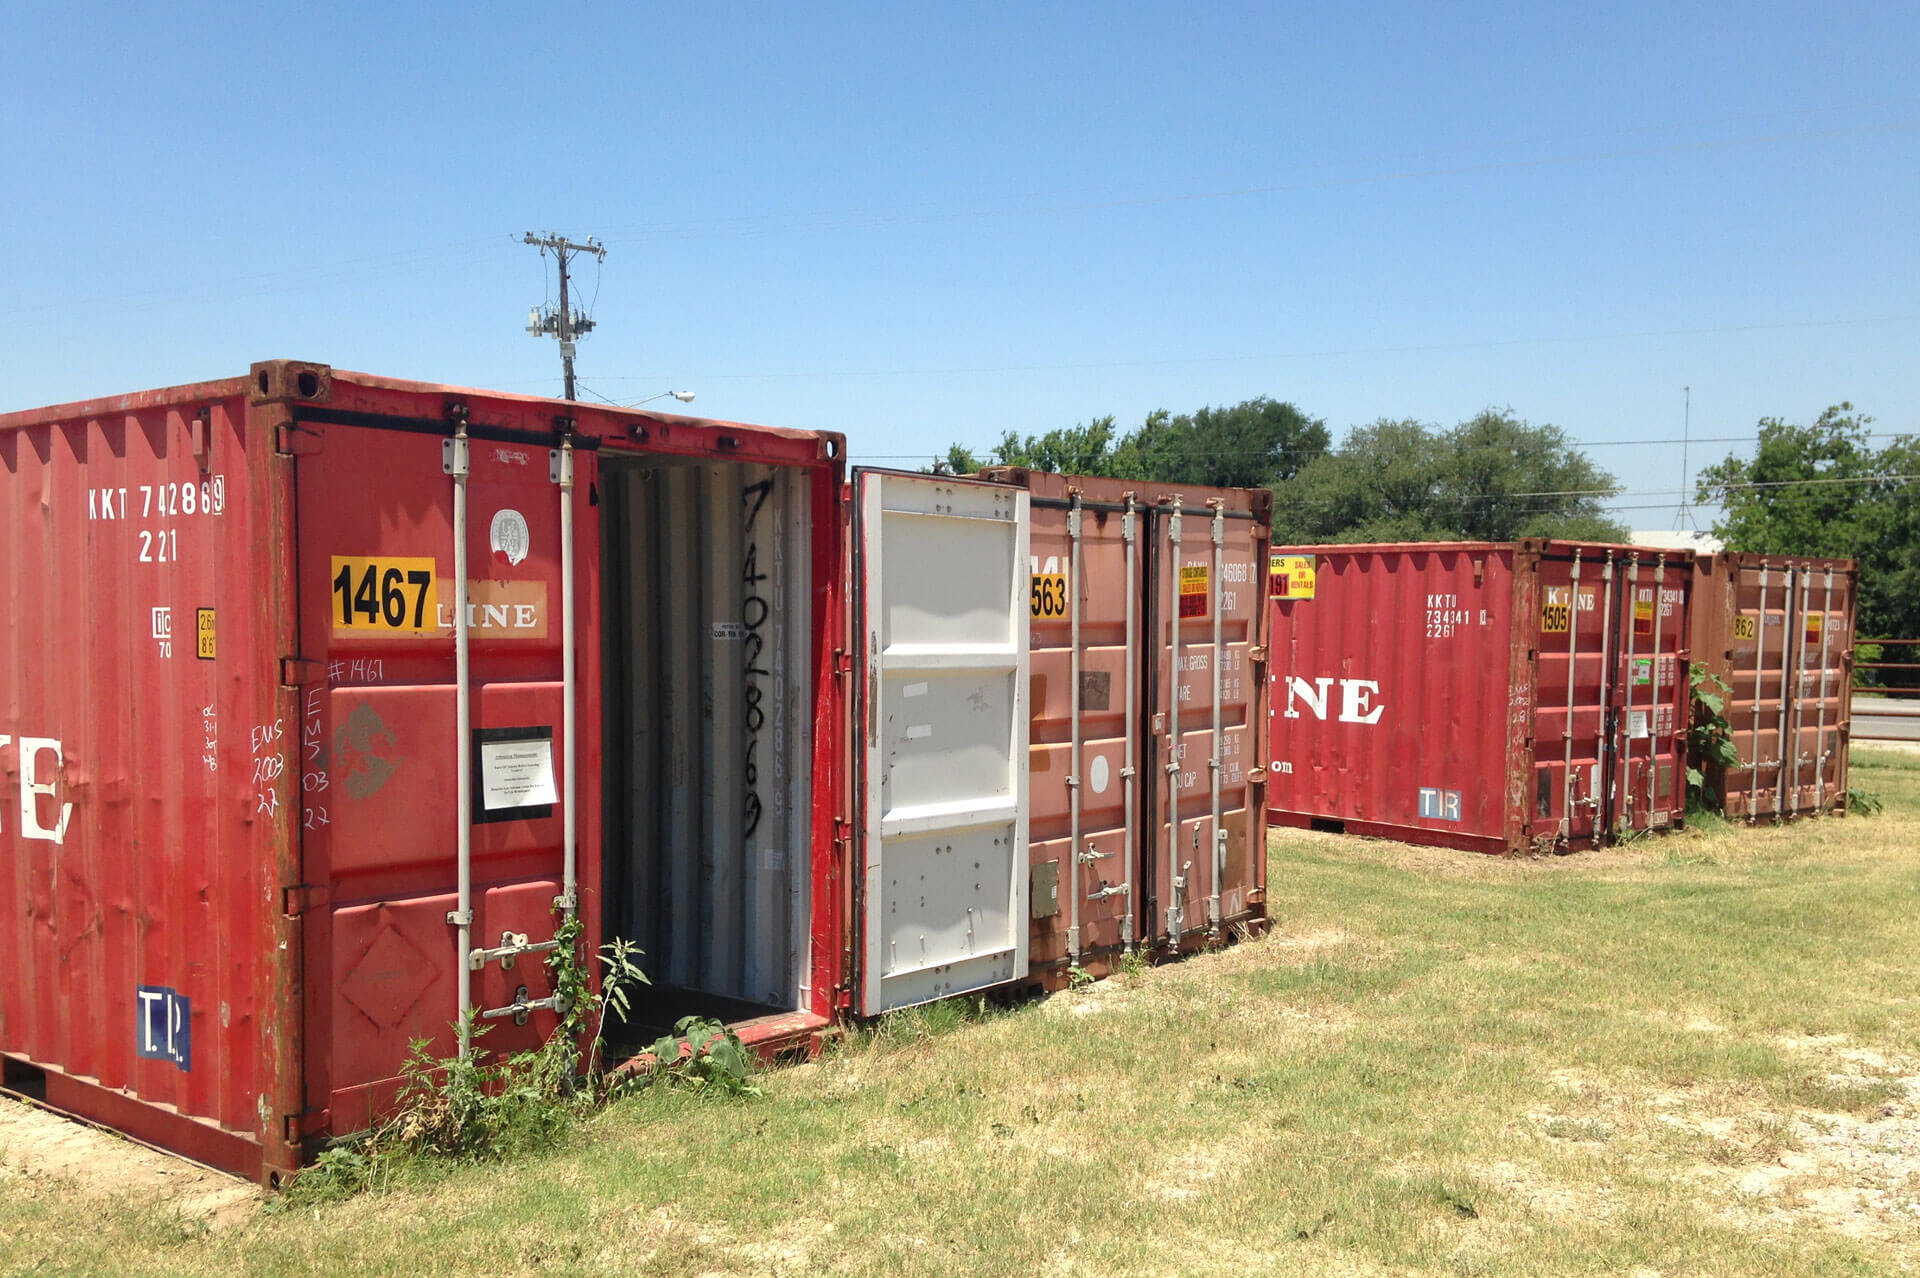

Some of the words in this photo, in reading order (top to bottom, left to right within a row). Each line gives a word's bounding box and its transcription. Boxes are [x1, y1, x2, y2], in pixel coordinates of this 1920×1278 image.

[139, 528, 177, 562] 221
[334, 564, 431, 628] 1467
[1427, 594, 1457, 608] KKTU
[1426, 610, 1470, 625] 734341
[1543, 606, 1567, 630] 1505
[1735, 618, 1753, 638] 862
[1190, 655, 1208, 671] GROSS
[1271, 675, 1385, 725] NE
[1420, 790, 1458, 819] TIR
